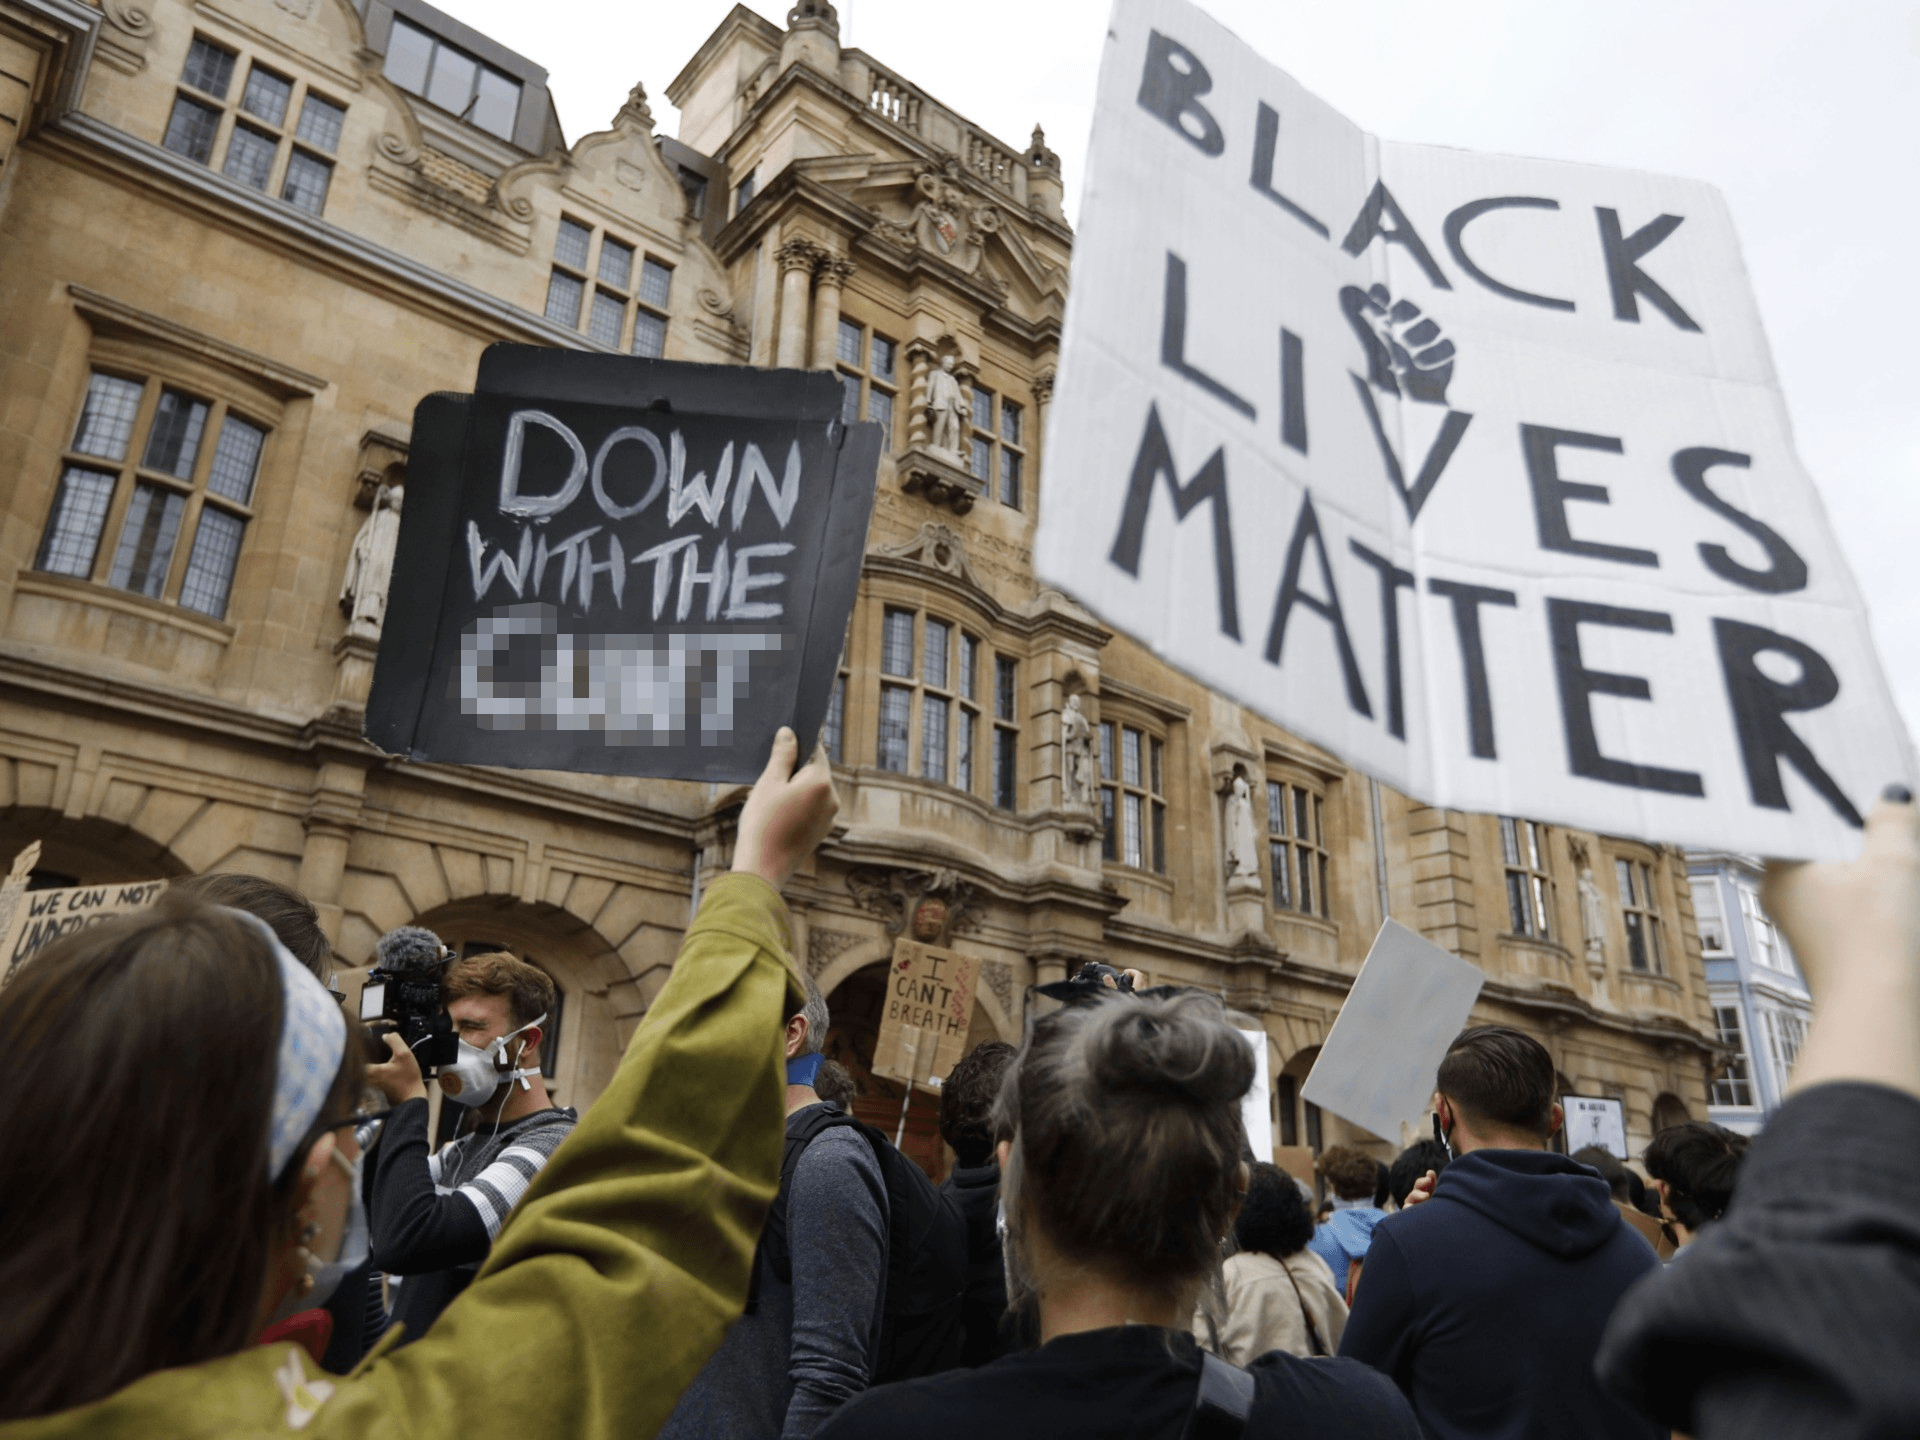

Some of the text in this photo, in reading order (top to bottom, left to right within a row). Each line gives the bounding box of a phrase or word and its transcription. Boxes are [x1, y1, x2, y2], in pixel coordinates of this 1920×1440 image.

[1136, 28, 1704, 334] BLACK
[500, 409, 801, 532] DOWN
[1160, 249, 1808, 596] LIVES
[466, 519, 796, 622] WITH THE
[1107, 399, 1865, 831] MATTER
[29, 882, 161, 917] WE CAN NOT
[922, 955, 948, 983] I
